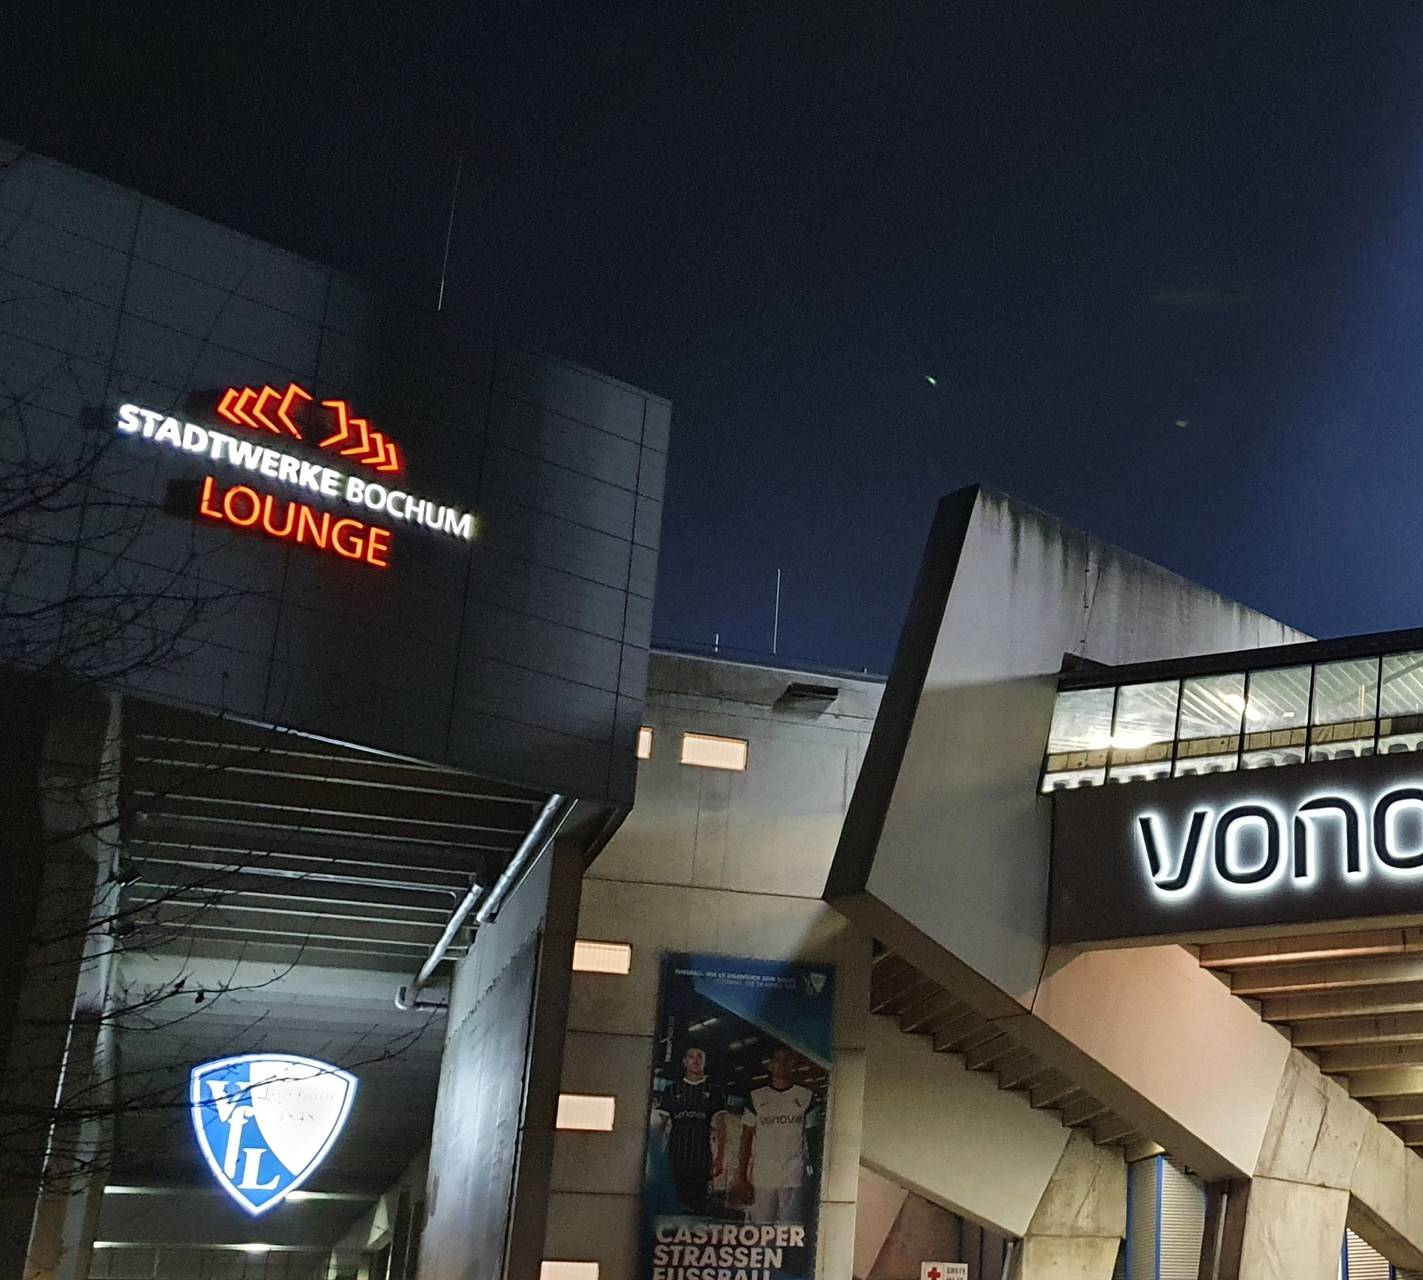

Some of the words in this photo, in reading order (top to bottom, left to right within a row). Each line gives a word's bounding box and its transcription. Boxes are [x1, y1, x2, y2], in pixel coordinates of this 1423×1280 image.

[117, 403, 341, 497] STADTWERKE
[346, 476, 475, 541] BOCHUM
[200, 475, 393, 567] LOUNGE
[205, 1080, 281, 1190] VfL
[653, 1245, 784, 1269] STRASSEN
[656, 1223, 806, 1248] CASTROPER
